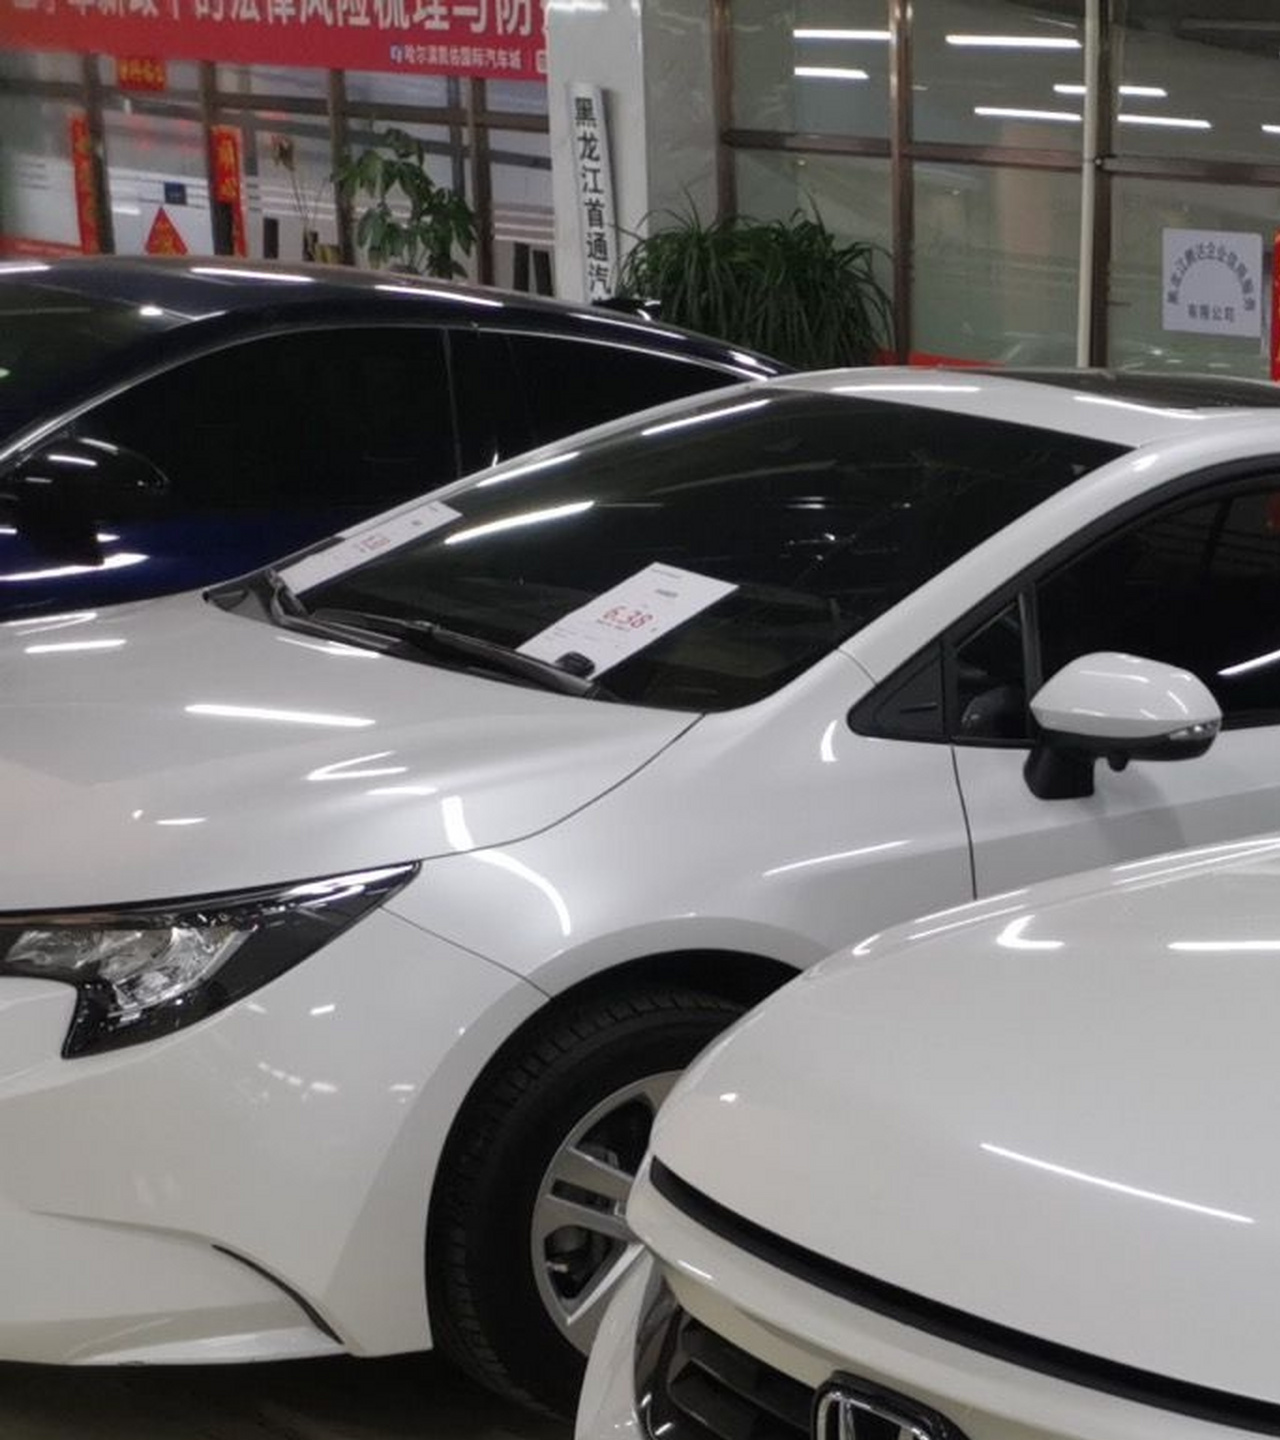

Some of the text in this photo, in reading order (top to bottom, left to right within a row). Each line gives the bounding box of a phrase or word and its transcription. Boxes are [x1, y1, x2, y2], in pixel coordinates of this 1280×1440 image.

[574, 96, 612, 301] 黑龙江首通汽
